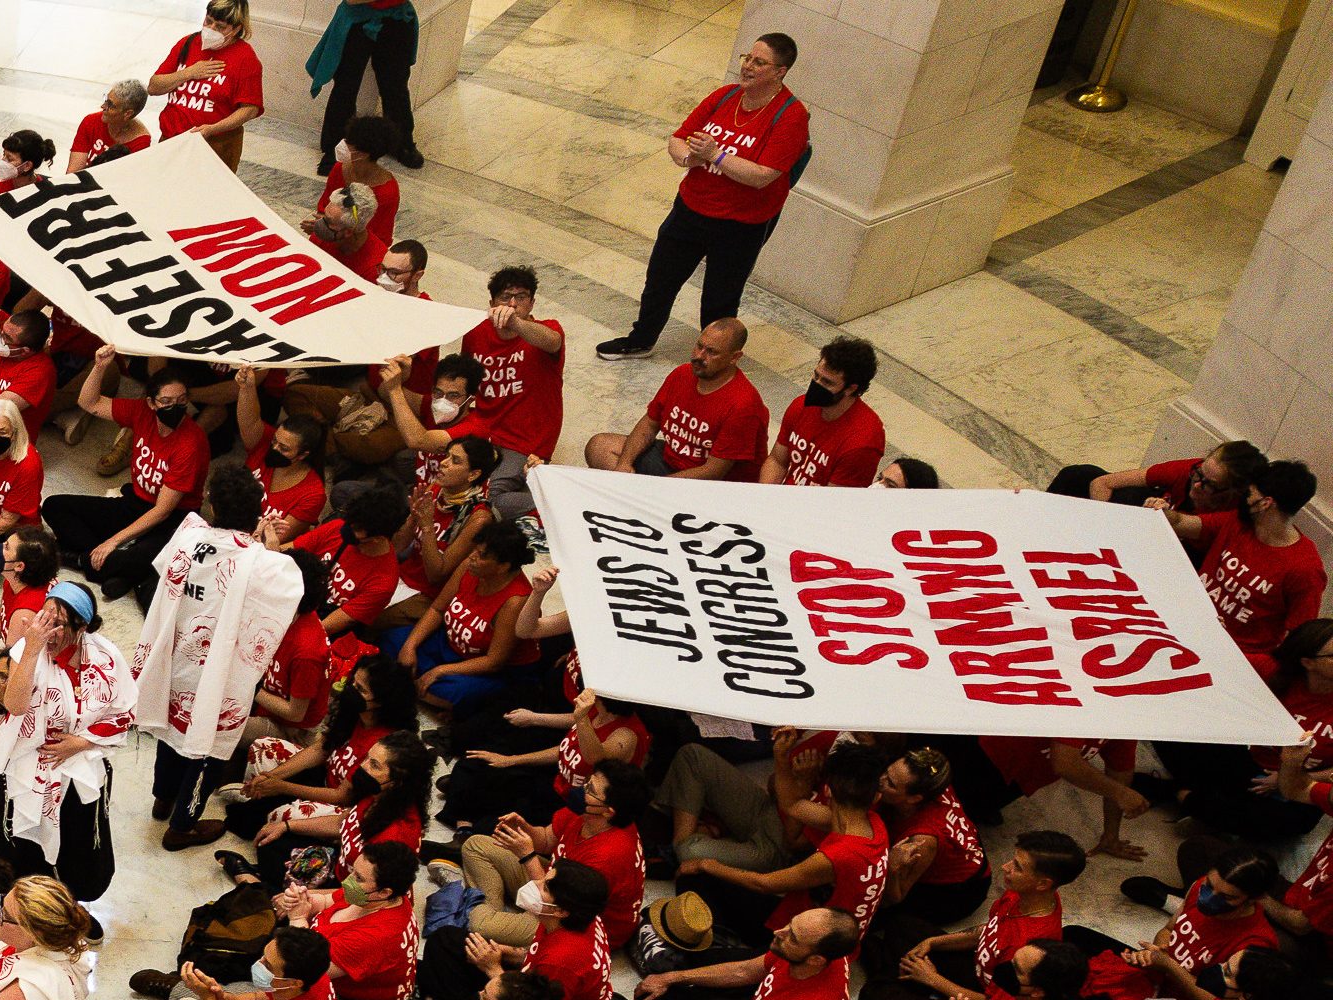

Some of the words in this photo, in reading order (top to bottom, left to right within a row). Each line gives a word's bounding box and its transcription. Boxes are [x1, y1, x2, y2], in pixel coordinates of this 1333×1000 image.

[168, 91, 214, 112] NAME
[702, 121, 735, 141] NOT
[734, 134, 757, 148] IN
[167, 216, 366, 326] NOW
[473, 352, 506, 367] NOT
[507, 350, 524, 364] IN
[670, 405, 710, 434] STOP
[789, 431, 815, 454] NOT
[814, 450, 829, 467] IN
[0, 480, 11, 493] IN
[583, 510, 669, 556] TO
[1215, 566, 1251, 604] OUR
[1221, 550, 1249, 577] NOT
[1248, 575, 1273, 594] IN
[599, 555, 703, 662] JEWS
[672, 512, 815, 699] CONGRESS
[790, 550, 930, 671] STOP
[892, 529, 1083, 707] ARMING
[1200, 573, 1253, 623] NAME
[470, 616, 487, 633] IN
[1024, 547, 1211, 696] ISRAEL
